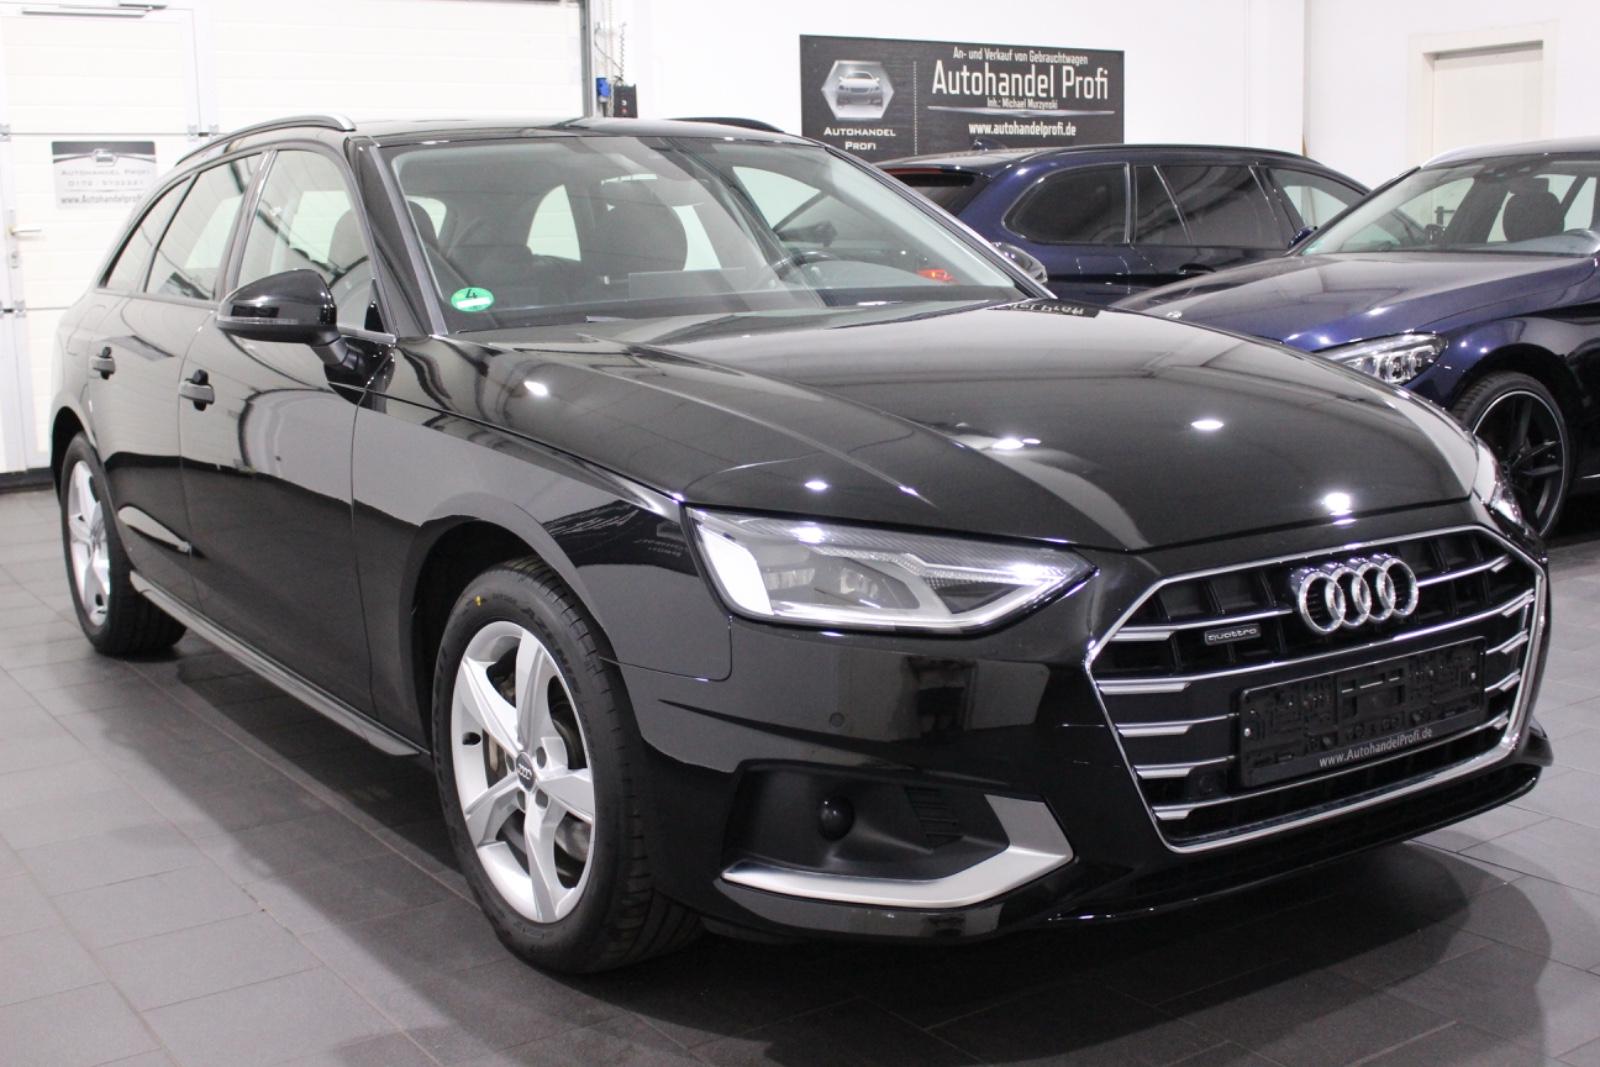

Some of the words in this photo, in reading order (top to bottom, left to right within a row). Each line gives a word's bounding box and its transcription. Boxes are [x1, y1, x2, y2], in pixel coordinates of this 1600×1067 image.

[953, 46, 967, 59] An-
[969, 48, 983, 60] und
[984, 48, 1013, 62] Verkauf
[1014, 52, 1028, 62] von
[1029, 50, 1088, 66] Gebrauchtwagen
[931, 59, 1055, 98] Autohandel
[1062, 65, 1109, 100] Profi
[1002, 97, 1027, 109] Michael
[823, 126, 896, 137] AUTOHANDEL
[968, 119, 1077, 138] www.autohandelprofi.de
[1208, 628, 1257, 641] quattro
[1319, 727, 1433, 767] www.AutohandelProfi.de
